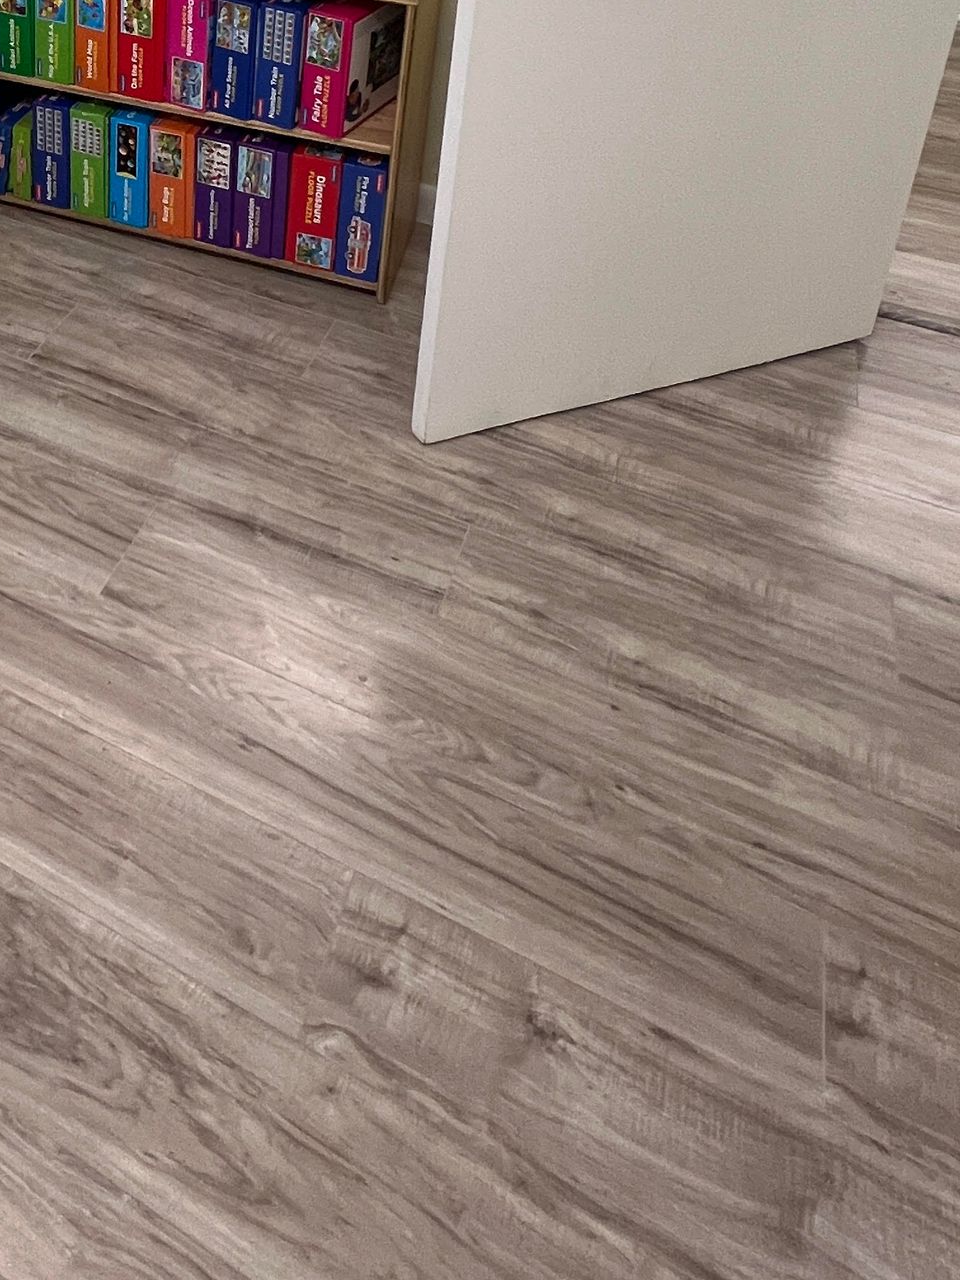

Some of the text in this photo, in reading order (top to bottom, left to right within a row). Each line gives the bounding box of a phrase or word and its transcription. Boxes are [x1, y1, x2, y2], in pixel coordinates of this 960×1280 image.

[186, 26, 194, 56] Animals
[131, 77, 138, 89] On
[268, 66, 278, 118] Number Train
[311, 75, 323, 122] Fairy Tale
[322, 75, 330, 102] PUZZLE
[305, 171, 315, 224] FLOOR PUZZLE
[313, 175, 326, 224] Dinosaurs
[358, 176, 369, 214] Fire Engine
[246, 197, 255, 249] Transportation
